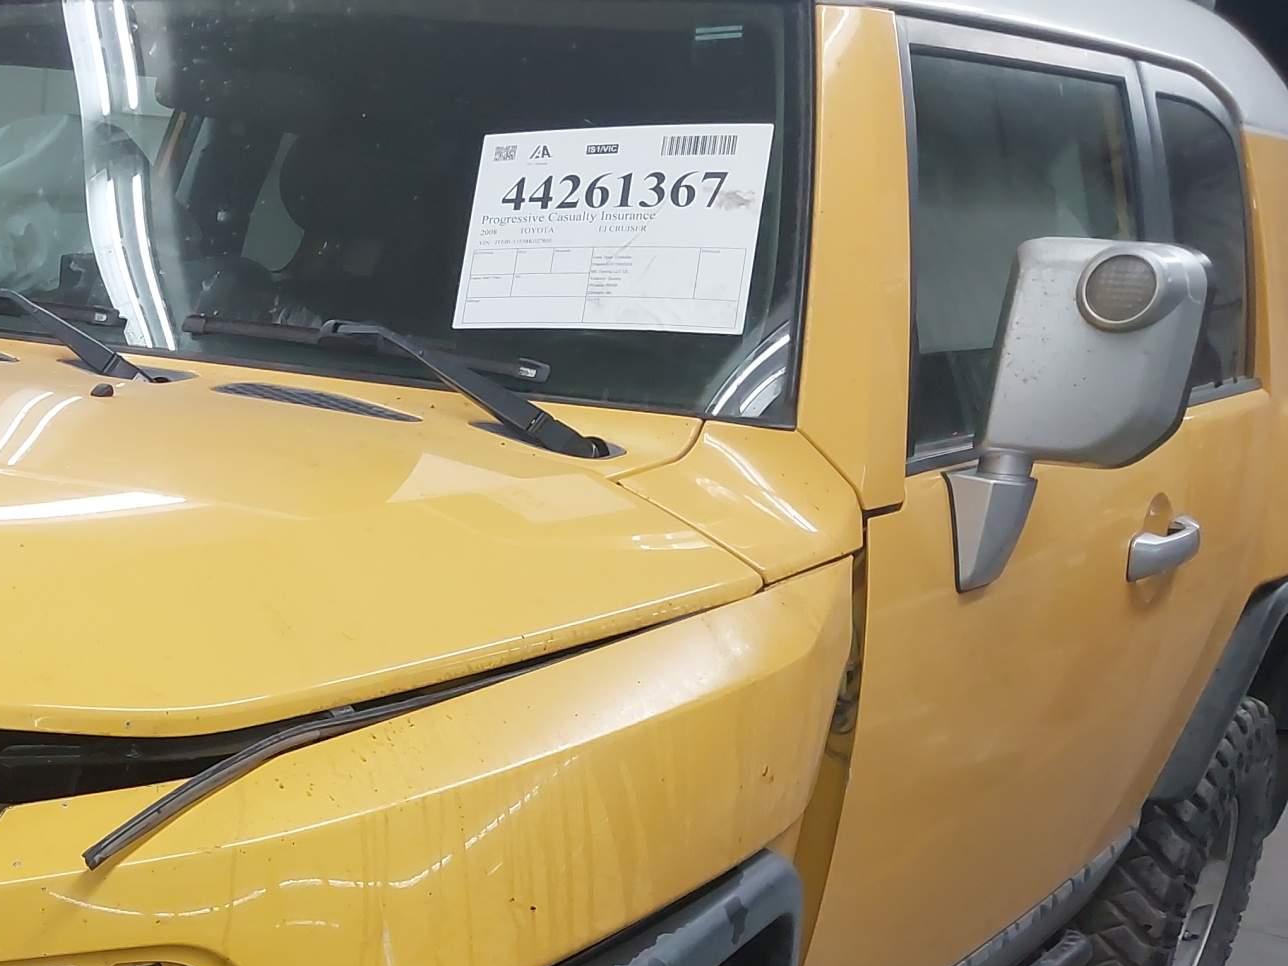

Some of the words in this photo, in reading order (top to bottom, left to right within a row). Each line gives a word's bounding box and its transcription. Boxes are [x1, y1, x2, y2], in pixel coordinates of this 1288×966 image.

[501, 171, 729, 211] 44261367
[481, 214, 545, 227] Progressive
[548, 212, 597, 224] Casualty
[601, 210, 656, 222] Insurance
